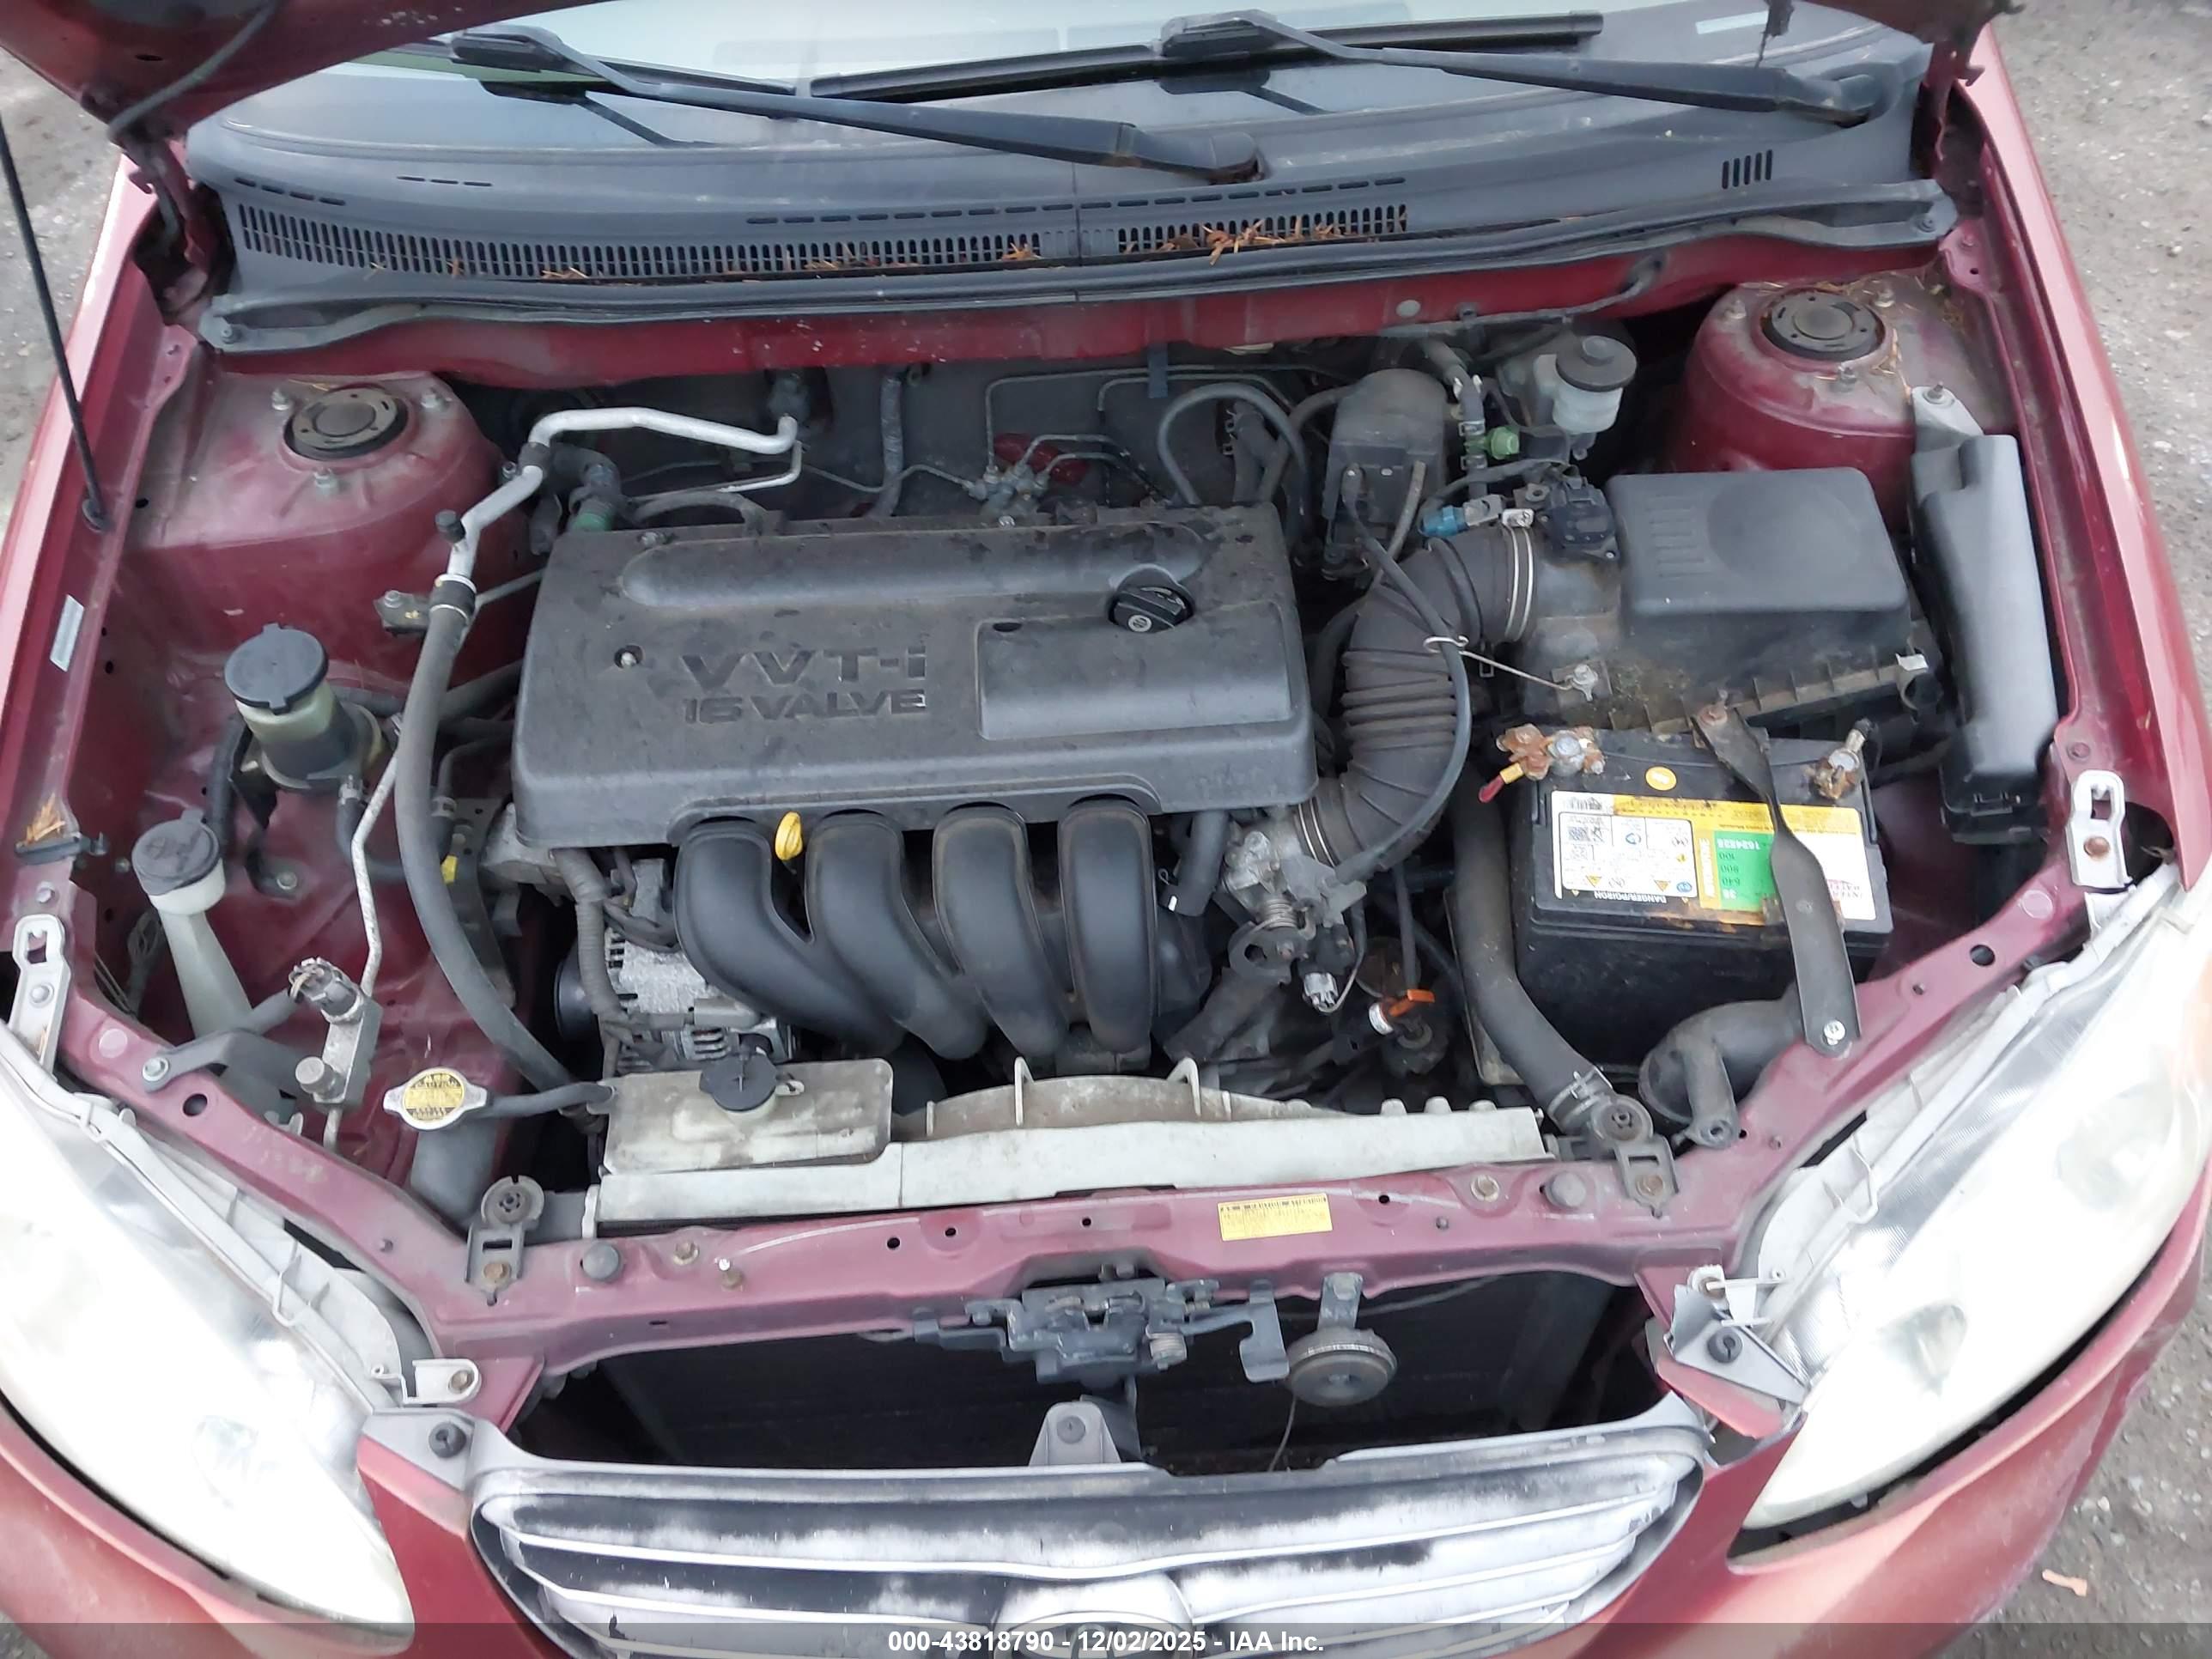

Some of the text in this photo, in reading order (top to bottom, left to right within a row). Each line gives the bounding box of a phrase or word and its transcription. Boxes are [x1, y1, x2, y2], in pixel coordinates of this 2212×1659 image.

[679, 645, 927, 691] VVT-i
[684, 689, 927, 724] 16 VALVE
